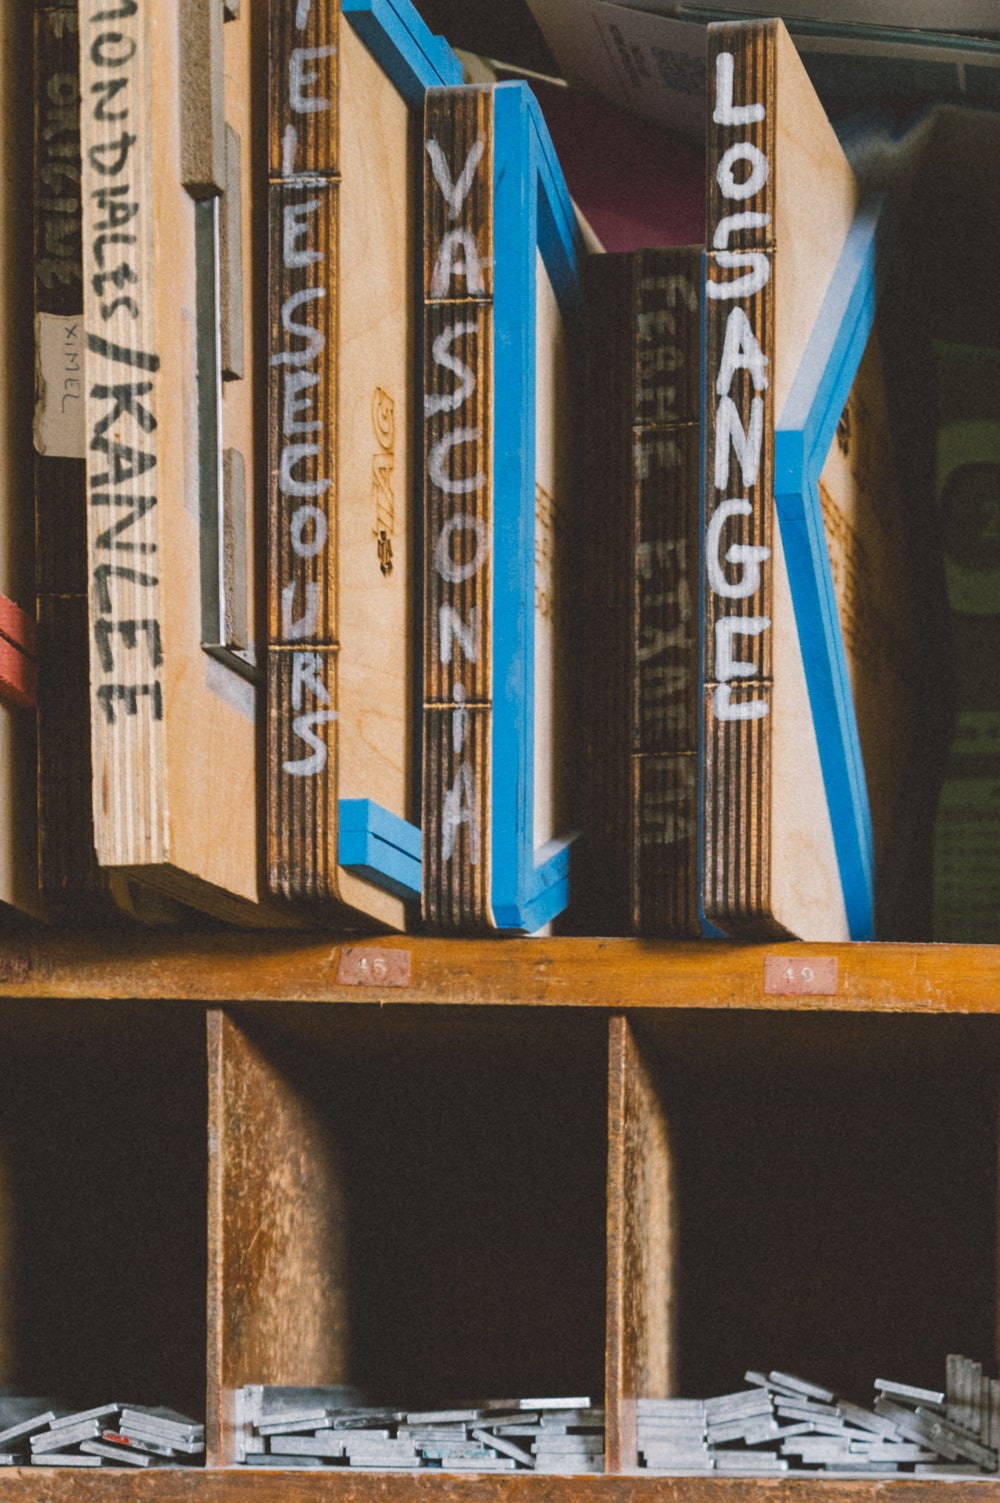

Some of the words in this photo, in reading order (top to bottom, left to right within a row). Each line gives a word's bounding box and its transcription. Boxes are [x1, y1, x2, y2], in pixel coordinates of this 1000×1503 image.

[708, 52, 770, 721] LOSANGE
[357, 957, 388, 977] 45
[782, 966, 815, 984] 40
